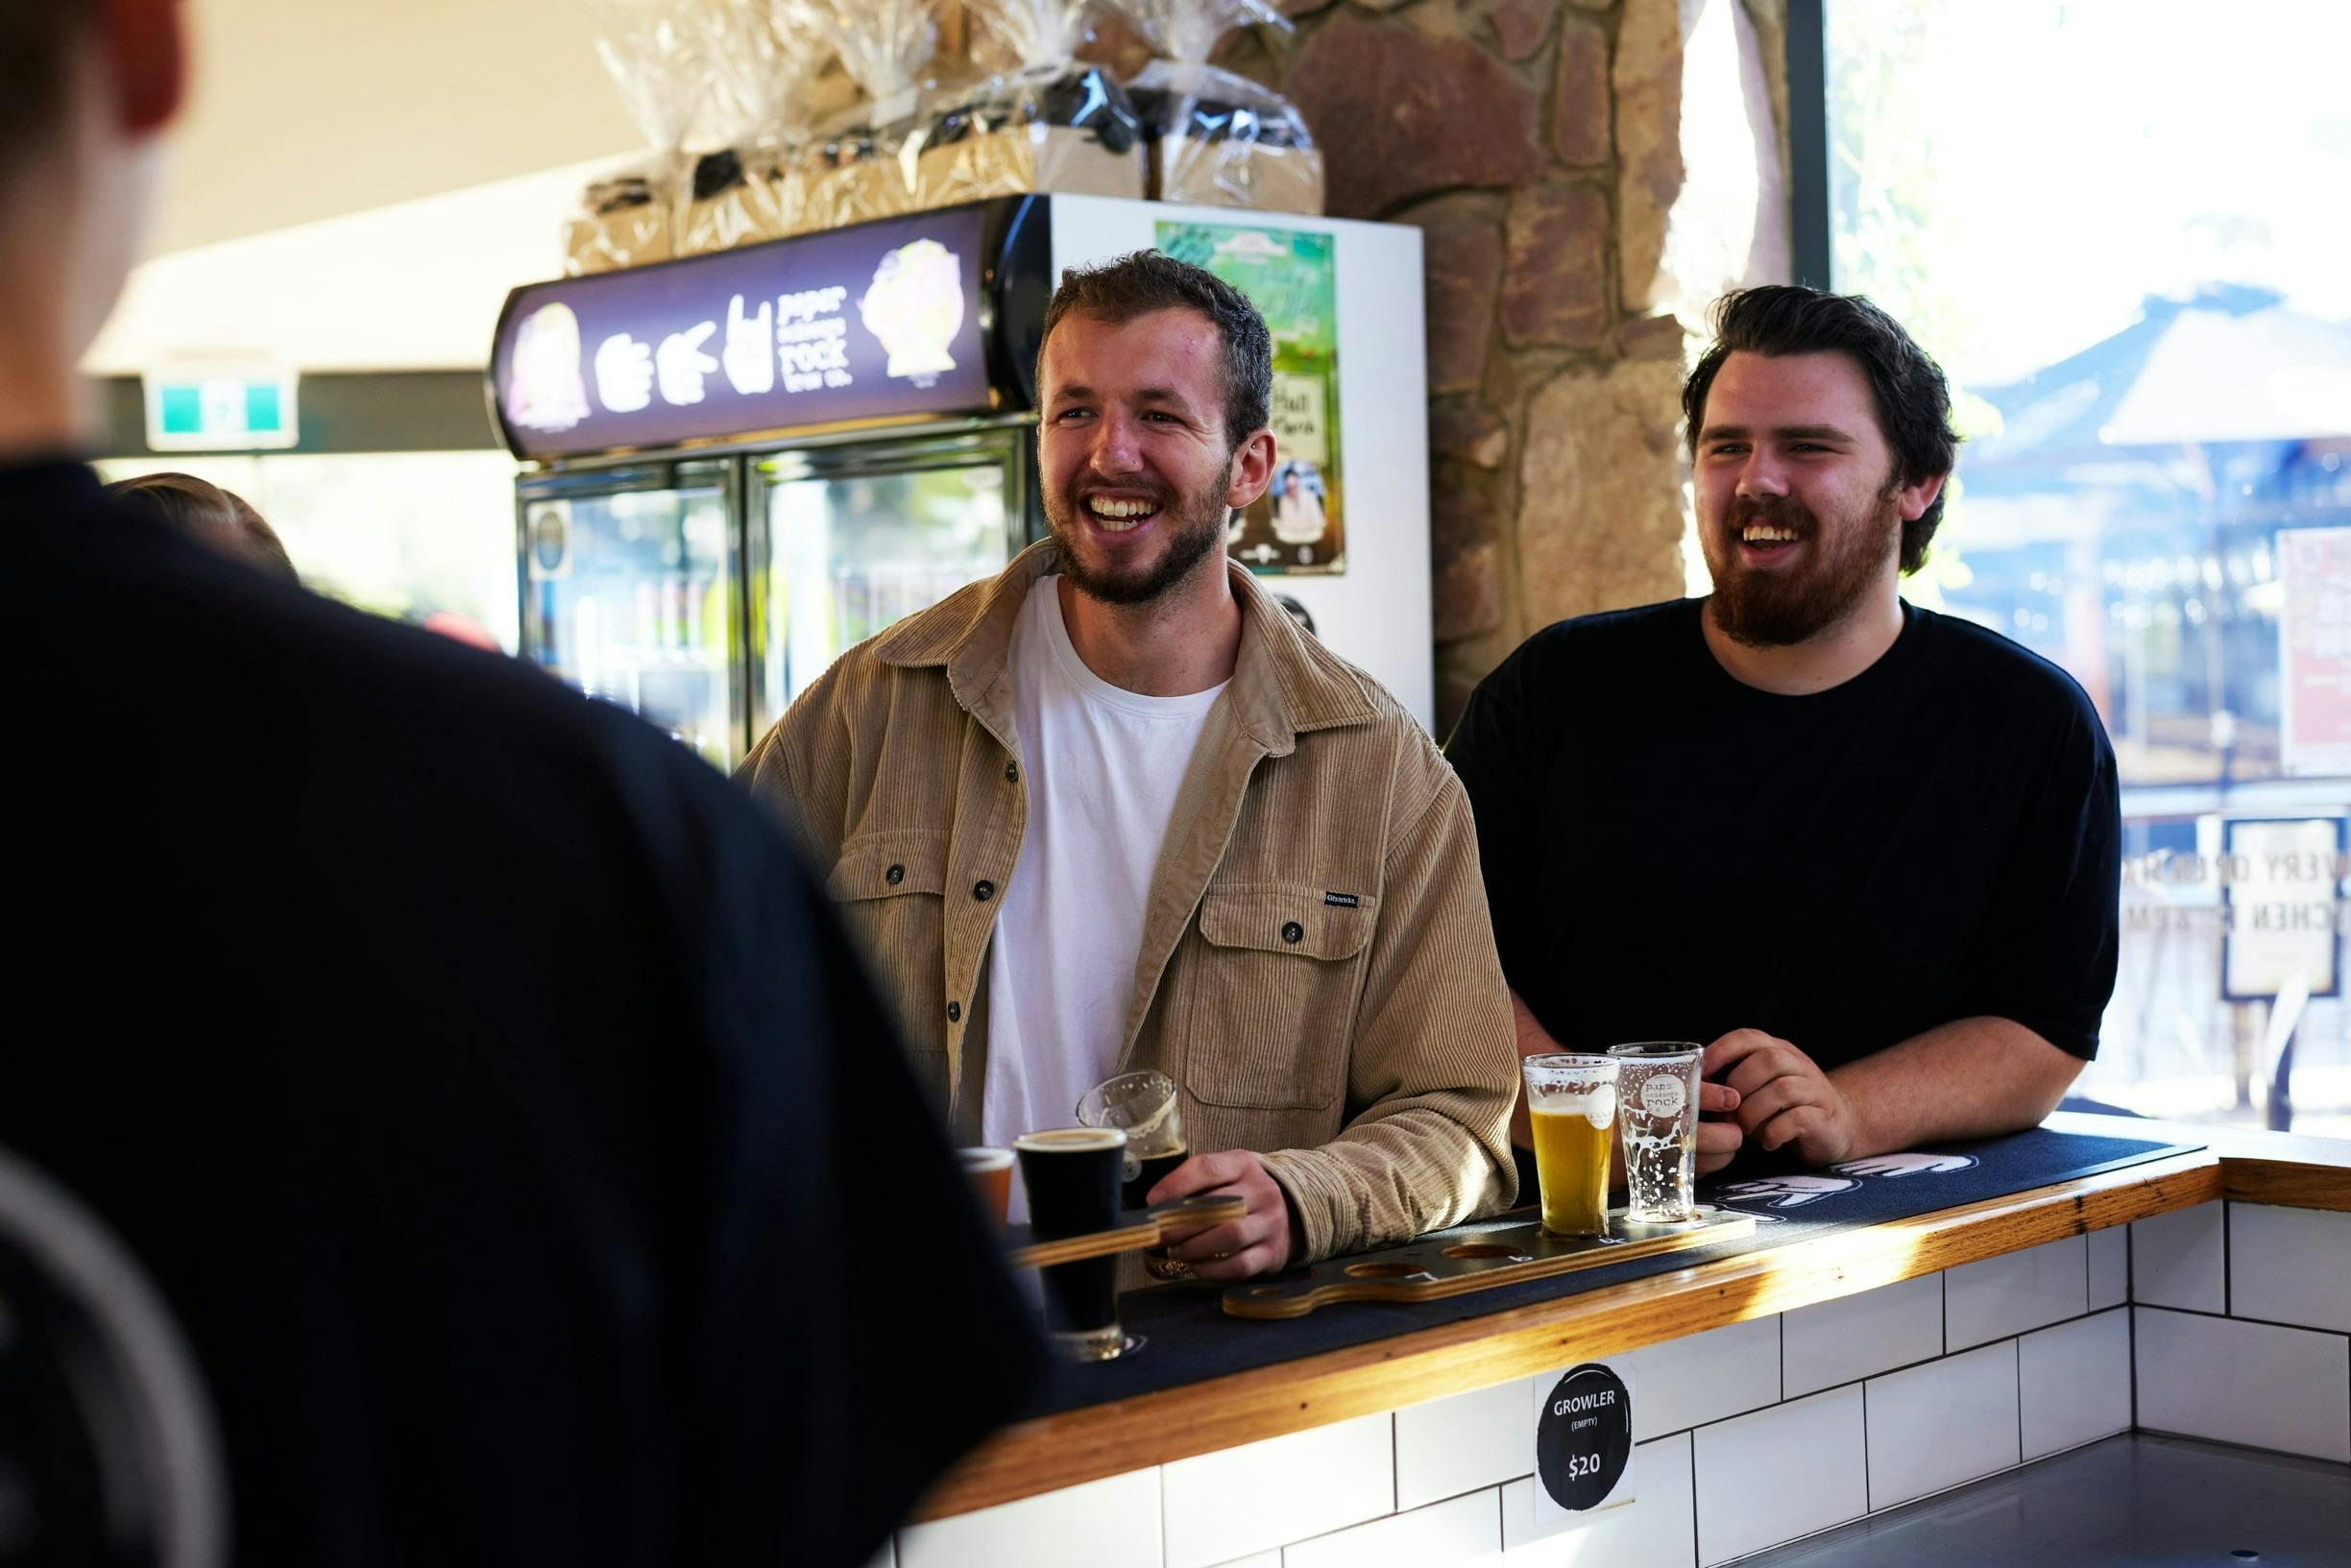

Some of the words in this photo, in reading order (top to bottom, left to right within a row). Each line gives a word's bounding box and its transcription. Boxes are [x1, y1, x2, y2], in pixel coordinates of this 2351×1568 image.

[1646, 1097, 1679, 1106] rock
[1554, 1389, 1615, 1416] GROWLER
[1571, 1416, 1598, 1432] (EMPTY)
[1568, 1453, 1601, 1482] $20
